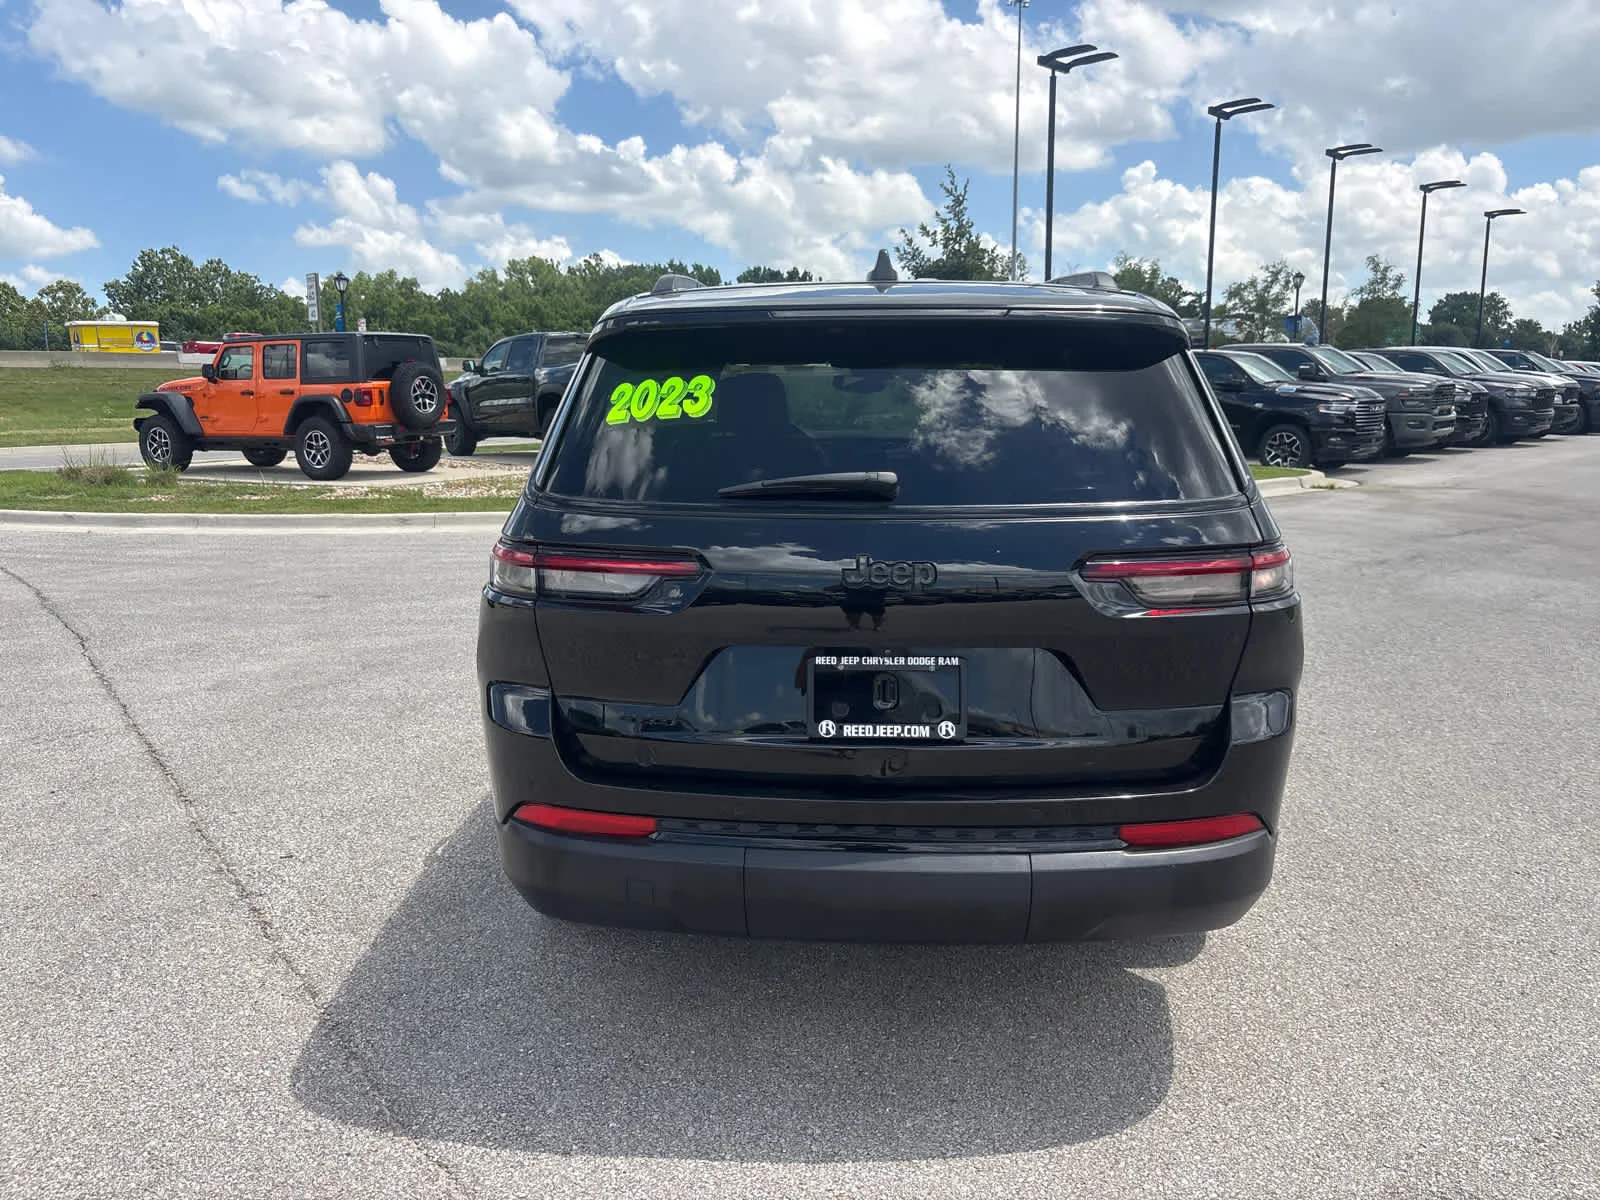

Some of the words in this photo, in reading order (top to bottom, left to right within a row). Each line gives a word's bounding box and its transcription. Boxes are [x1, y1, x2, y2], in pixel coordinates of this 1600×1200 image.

[606, 374, 716, 425] 2023
[842, 554, 937, 590] Jeep
[815, 656, 837, 665] REED
[840, 656, 860, 665] JEEP
[862, 656, 905, 666] CHRYSLER
[907, 656, 936, 666] DODGE
[938, 656, 959, 666] RAM
[843, 724, 930, 738] REEDJEEP.COM
